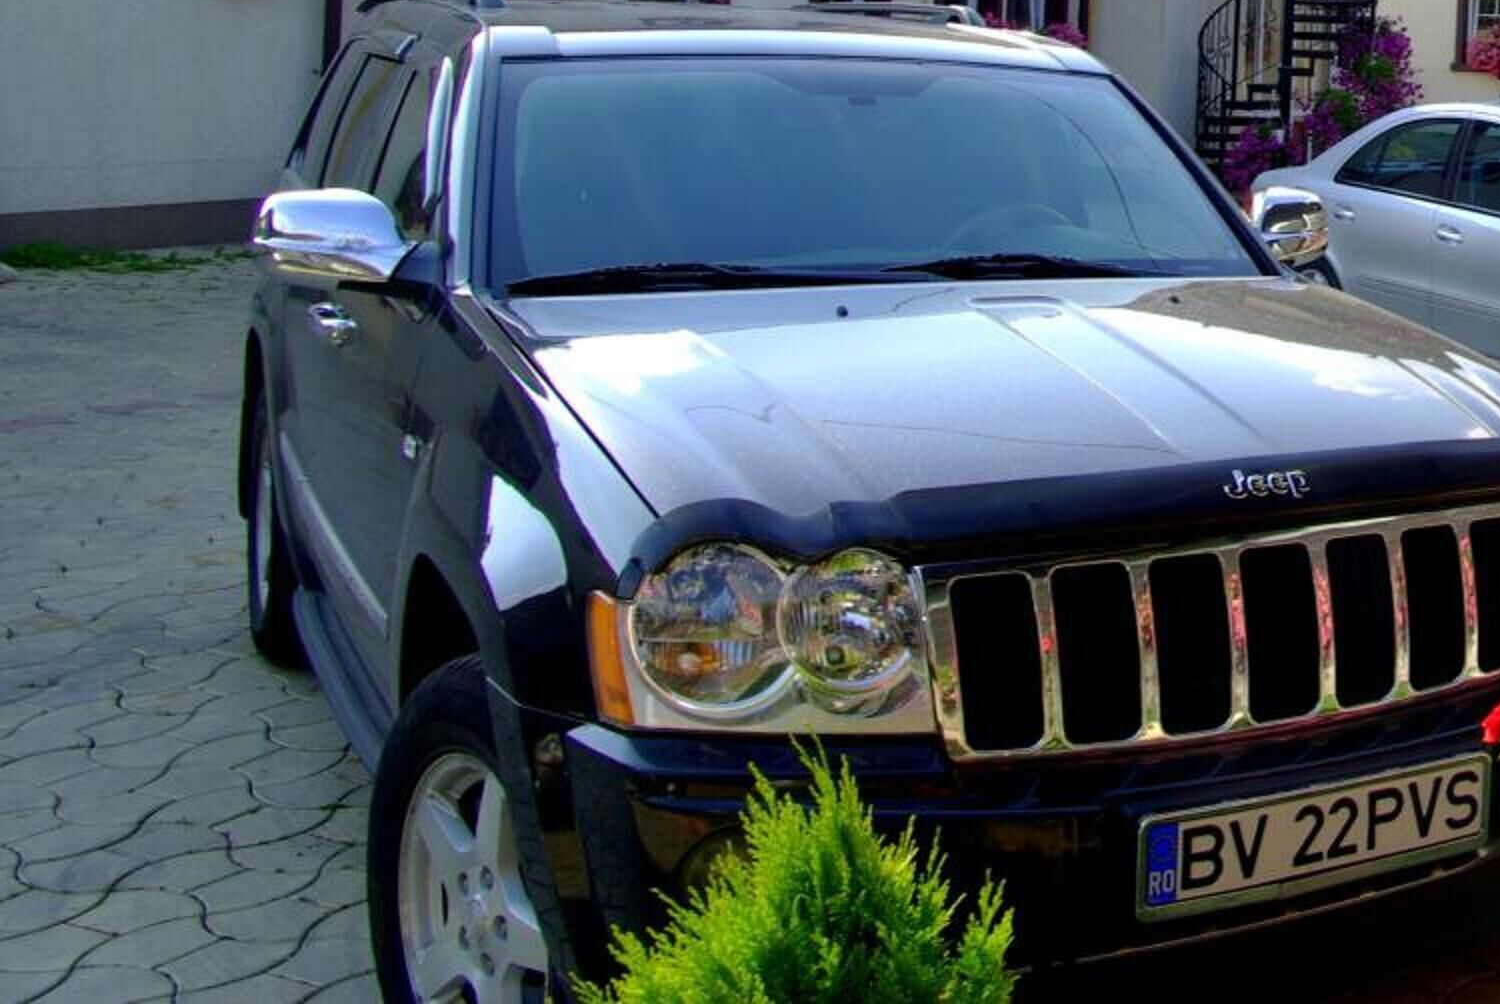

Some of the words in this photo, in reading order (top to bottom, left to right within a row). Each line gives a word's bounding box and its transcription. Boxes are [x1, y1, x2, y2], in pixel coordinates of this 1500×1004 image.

[1223, 468, 1311, 498] Jeep
[1181, 814, 1268, 891] BV
[1148, 869, 1176, 896] RO
